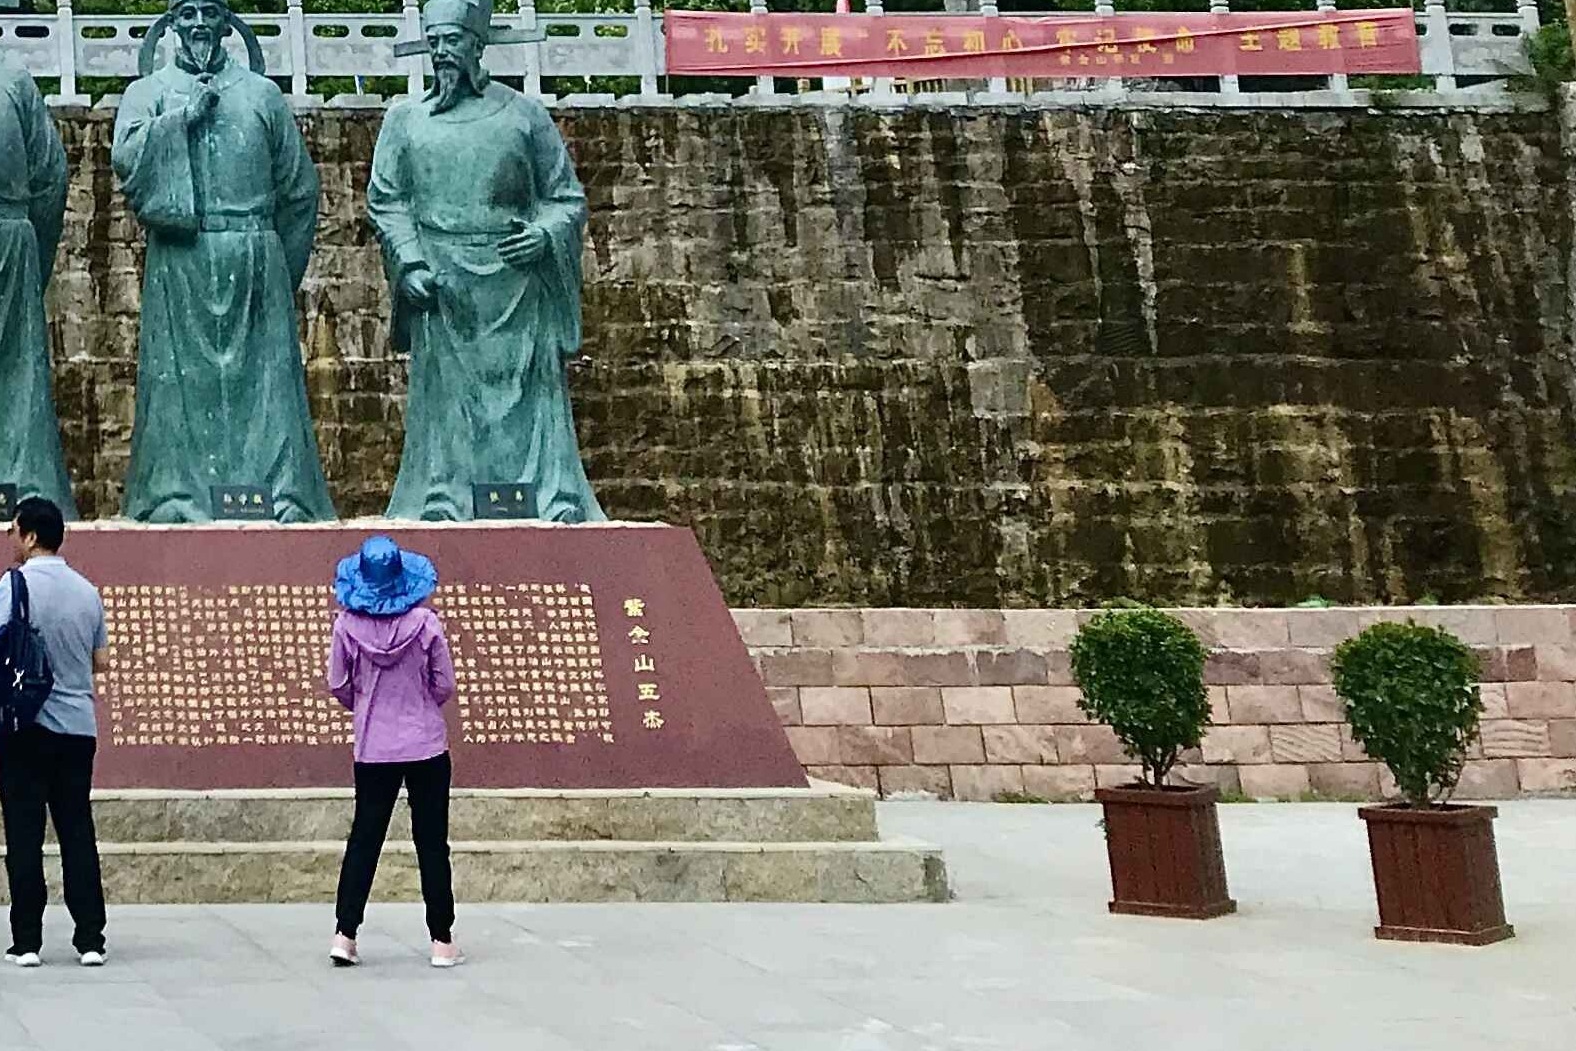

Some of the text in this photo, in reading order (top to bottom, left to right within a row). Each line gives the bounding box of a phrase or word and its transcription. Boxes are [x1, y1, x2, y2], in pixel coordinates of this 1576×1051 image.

[623, 598, 665, 729] 紫金山五杰
